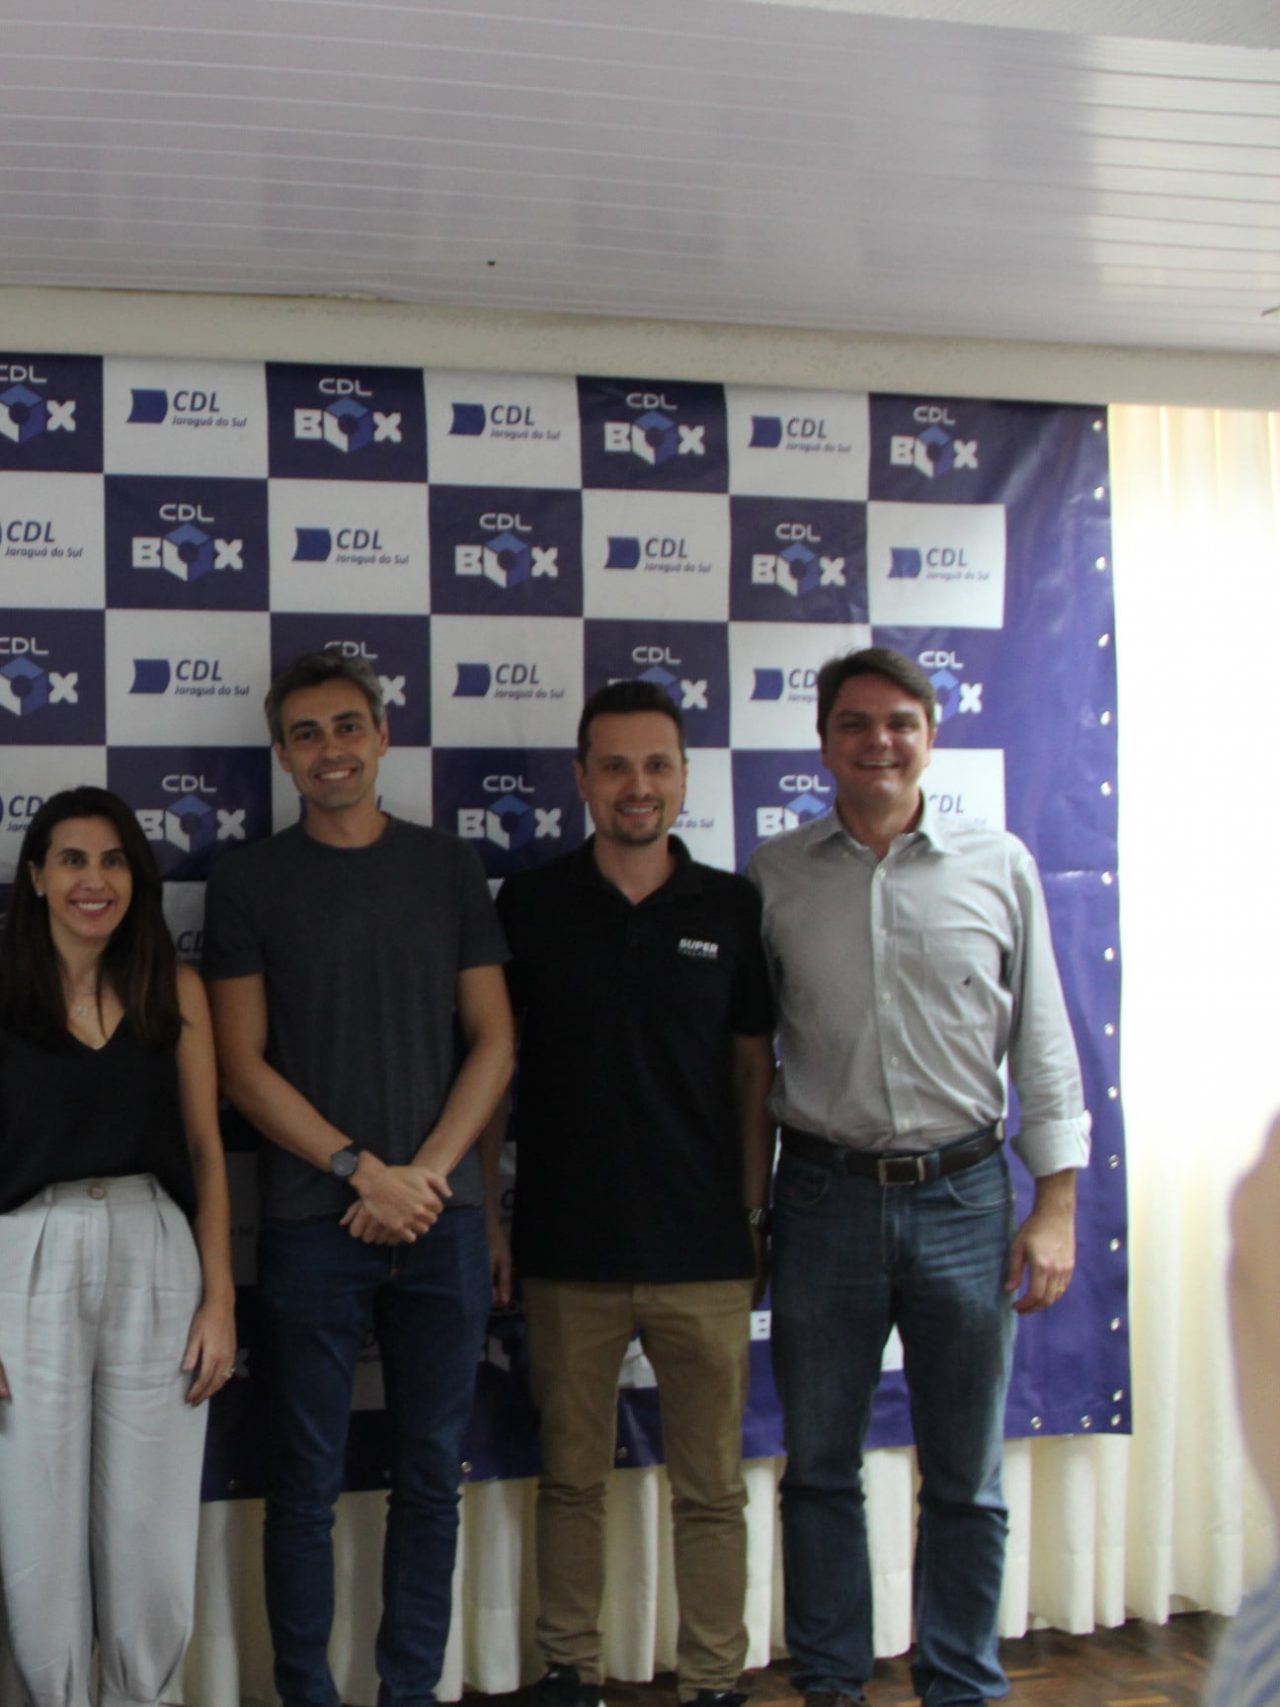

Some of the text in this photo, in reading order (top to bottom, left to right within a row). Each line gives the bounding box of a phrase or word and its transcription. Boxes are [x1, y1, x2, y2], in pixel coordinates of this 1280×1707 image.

[319, 378, 372, 396] CDL
[172, 390, 220, 412] CDL
[626, 393, 677, 409] CDL
[218, 417, 230, 427] do
[232, 417, 247, 427] Sul
[294, 397, 402, 453] BOX
[490, 405, 534, 425] CDL
[913, 406, 955, 425] CDL
[787, 418, 827, 438] CDL
[604, 411, 705, 466] BOX
[890, 425, 978, 478] BOX
[160, 504, 214, 522] CDL
[479, 513, 532, 531] CDL
[6, 521, 55, 542] CDL
[336, 529, 382, 550] CDL
[776, 523, 821, 542] CDL
[5, 547, 83, 559] Jaraguá do Sul
[132, 523, 243, 581] BOX
[645, 538, 687, 559] CDL
[926, 548, 967, 567] CDL
[456, 532, 558, 589] BOX
[752, 543, 846, 596] BOX
[632, 646, 681, 664] CDL
[919, 651, 964, 670] CDL
[175, 659, 223, 681] CDL
[495, 664, 539, 684] CDL
[789, 668, 817, 688] CD
[218, 686, 230, 696] do
[232, 686, 249, 696] Sul
[162, 775, 216, 792] CDL
[483, 776, 534, 791] CDL
[780, 775, 830, 792] CDL
[8, 795, 44, 818] CD
[458, 795, 561, 849] BOX
[679, 938, 719, 952] SUPER
